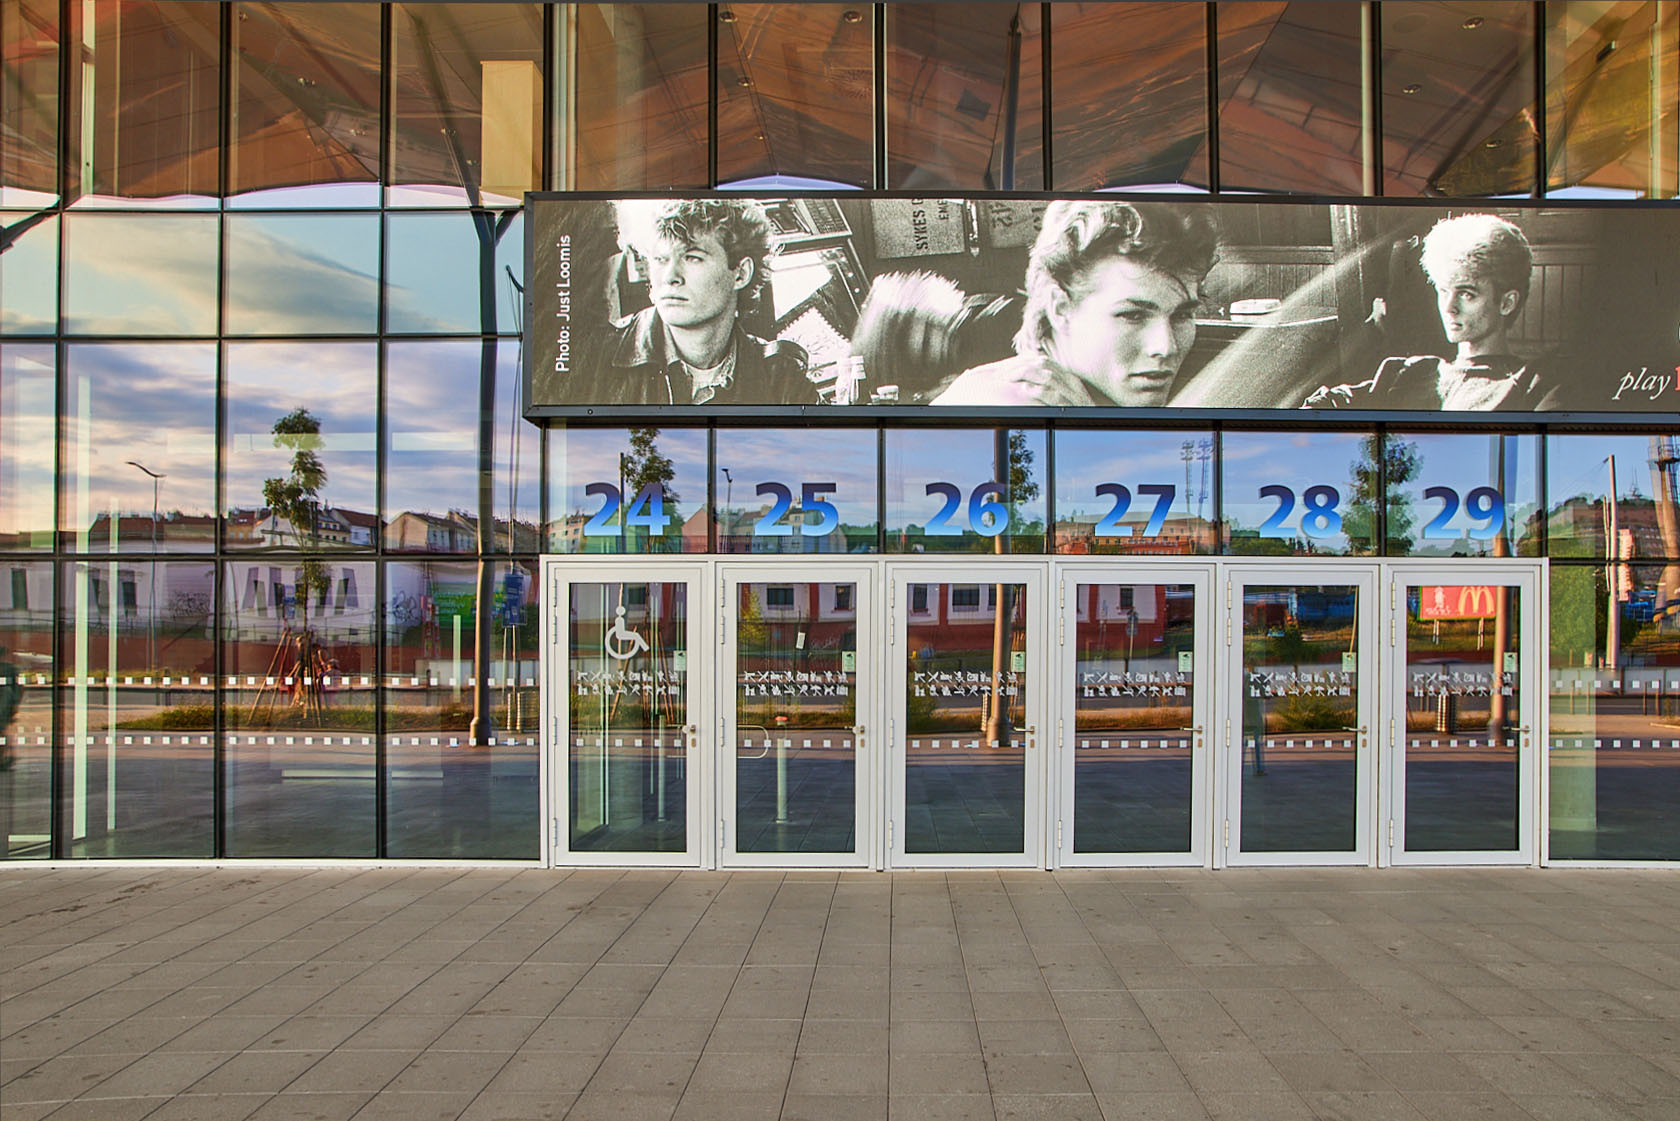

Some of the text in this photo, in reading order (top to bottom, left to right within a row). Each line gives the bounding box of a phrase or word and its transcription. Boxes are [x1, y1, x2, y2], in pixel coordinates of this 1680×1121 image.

[912, 209, 929, 250] SYKES
[555, 234, 571, 372] Photo: Just Loomis
[1611, 367, 1671, 400] play
[584, 481, 670, 537] 24
[754, 481, 839, 537] 25
[924, 482, 1009, 537] 26
[1094, 483, 1176, 538] 27
[1259, 484, 1343, 540] 28
[1424, 486, 1505, 540] 29
